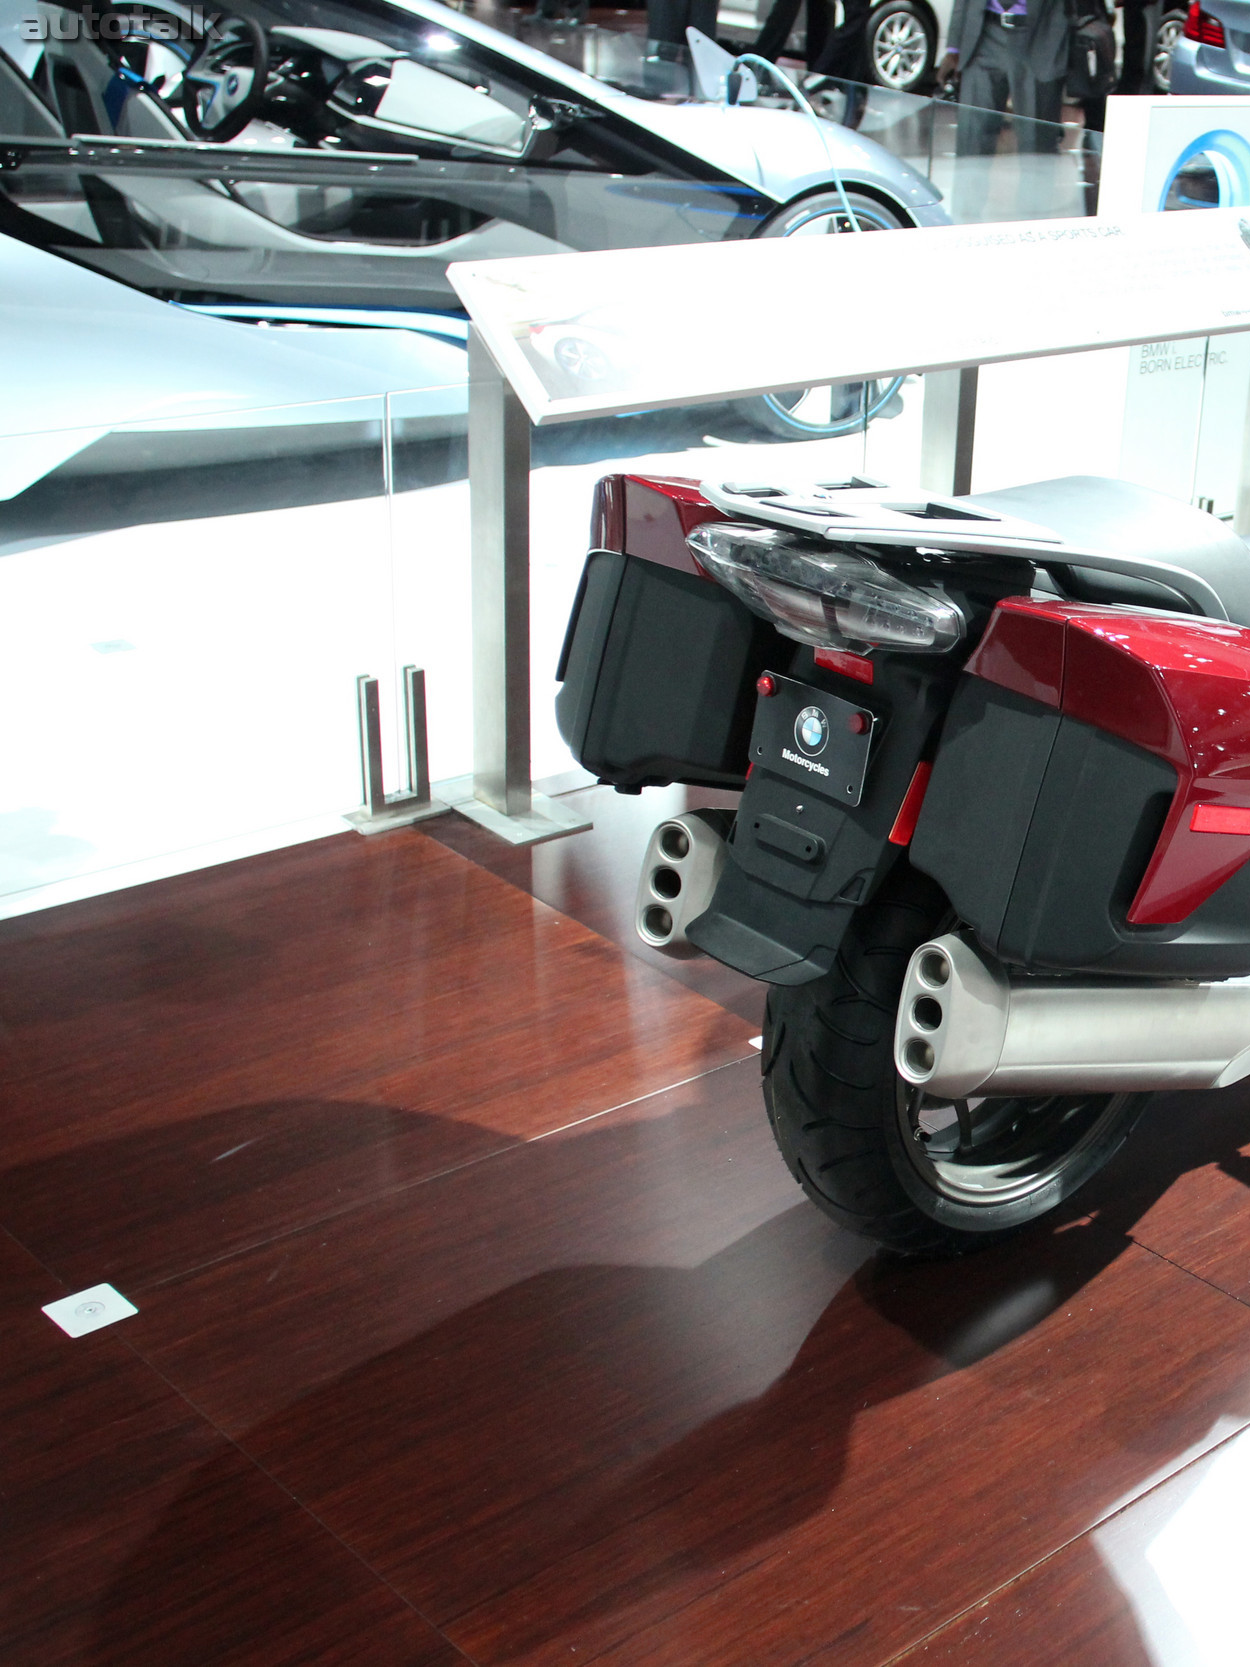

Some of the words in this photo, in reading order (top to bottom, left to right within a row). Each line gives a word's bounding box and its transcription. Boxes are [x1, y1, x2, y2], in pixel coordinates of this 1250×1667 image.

[1018, 231, 1036, 242] AS
[1047, 228, 1097, 241] SPORTS
[1098, 225, 1125, 238] CAR
[1141, 342, 1170, 358] BMW
[1139, 358, 1172, 375] BORN
[1174, 350, 1228, 371] ELECRIC.
[800, 708, 828, 729] BMW
[781, 747, 830, 777] Motorcycles
